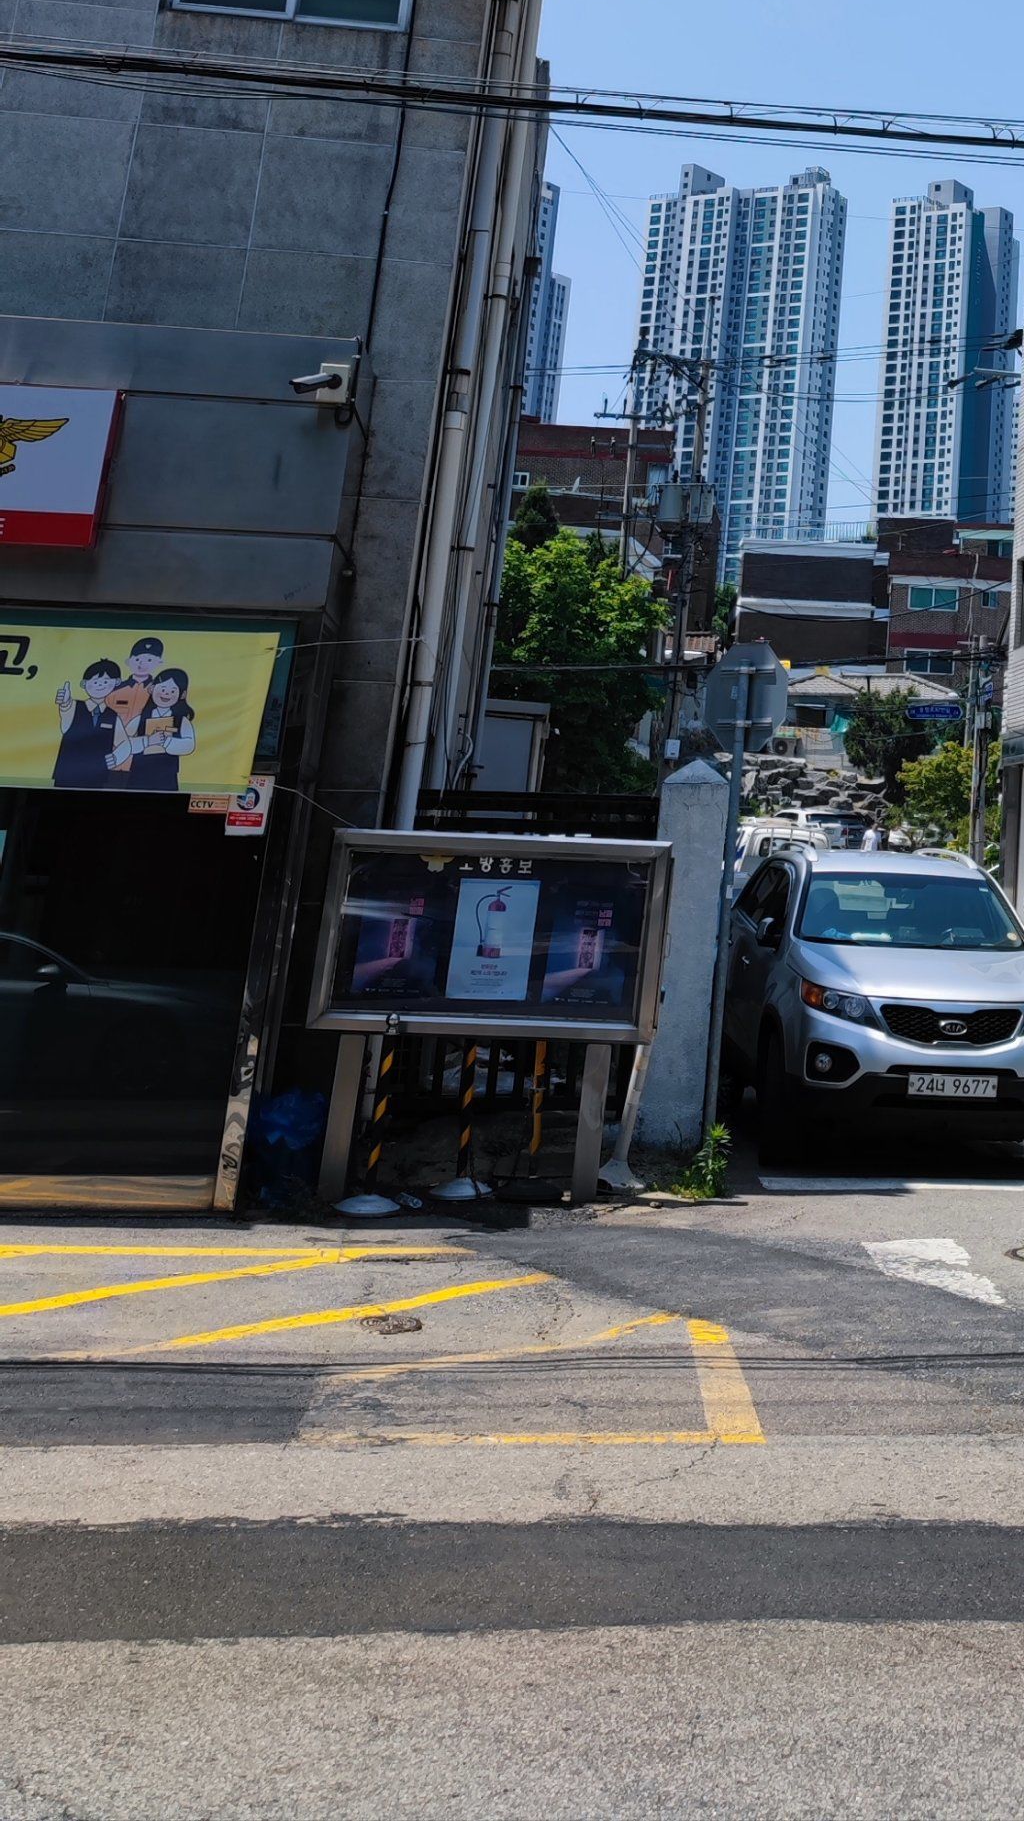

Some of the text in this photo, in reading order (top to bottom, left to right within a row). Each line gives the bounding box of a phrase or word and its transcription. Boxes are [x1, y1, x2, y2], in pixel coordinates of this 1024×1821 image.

[191, 800, 214, 809] CCTV
[945, 1024, 963, 1032] KIA
[952, 1078, 990, 1095] 9677
